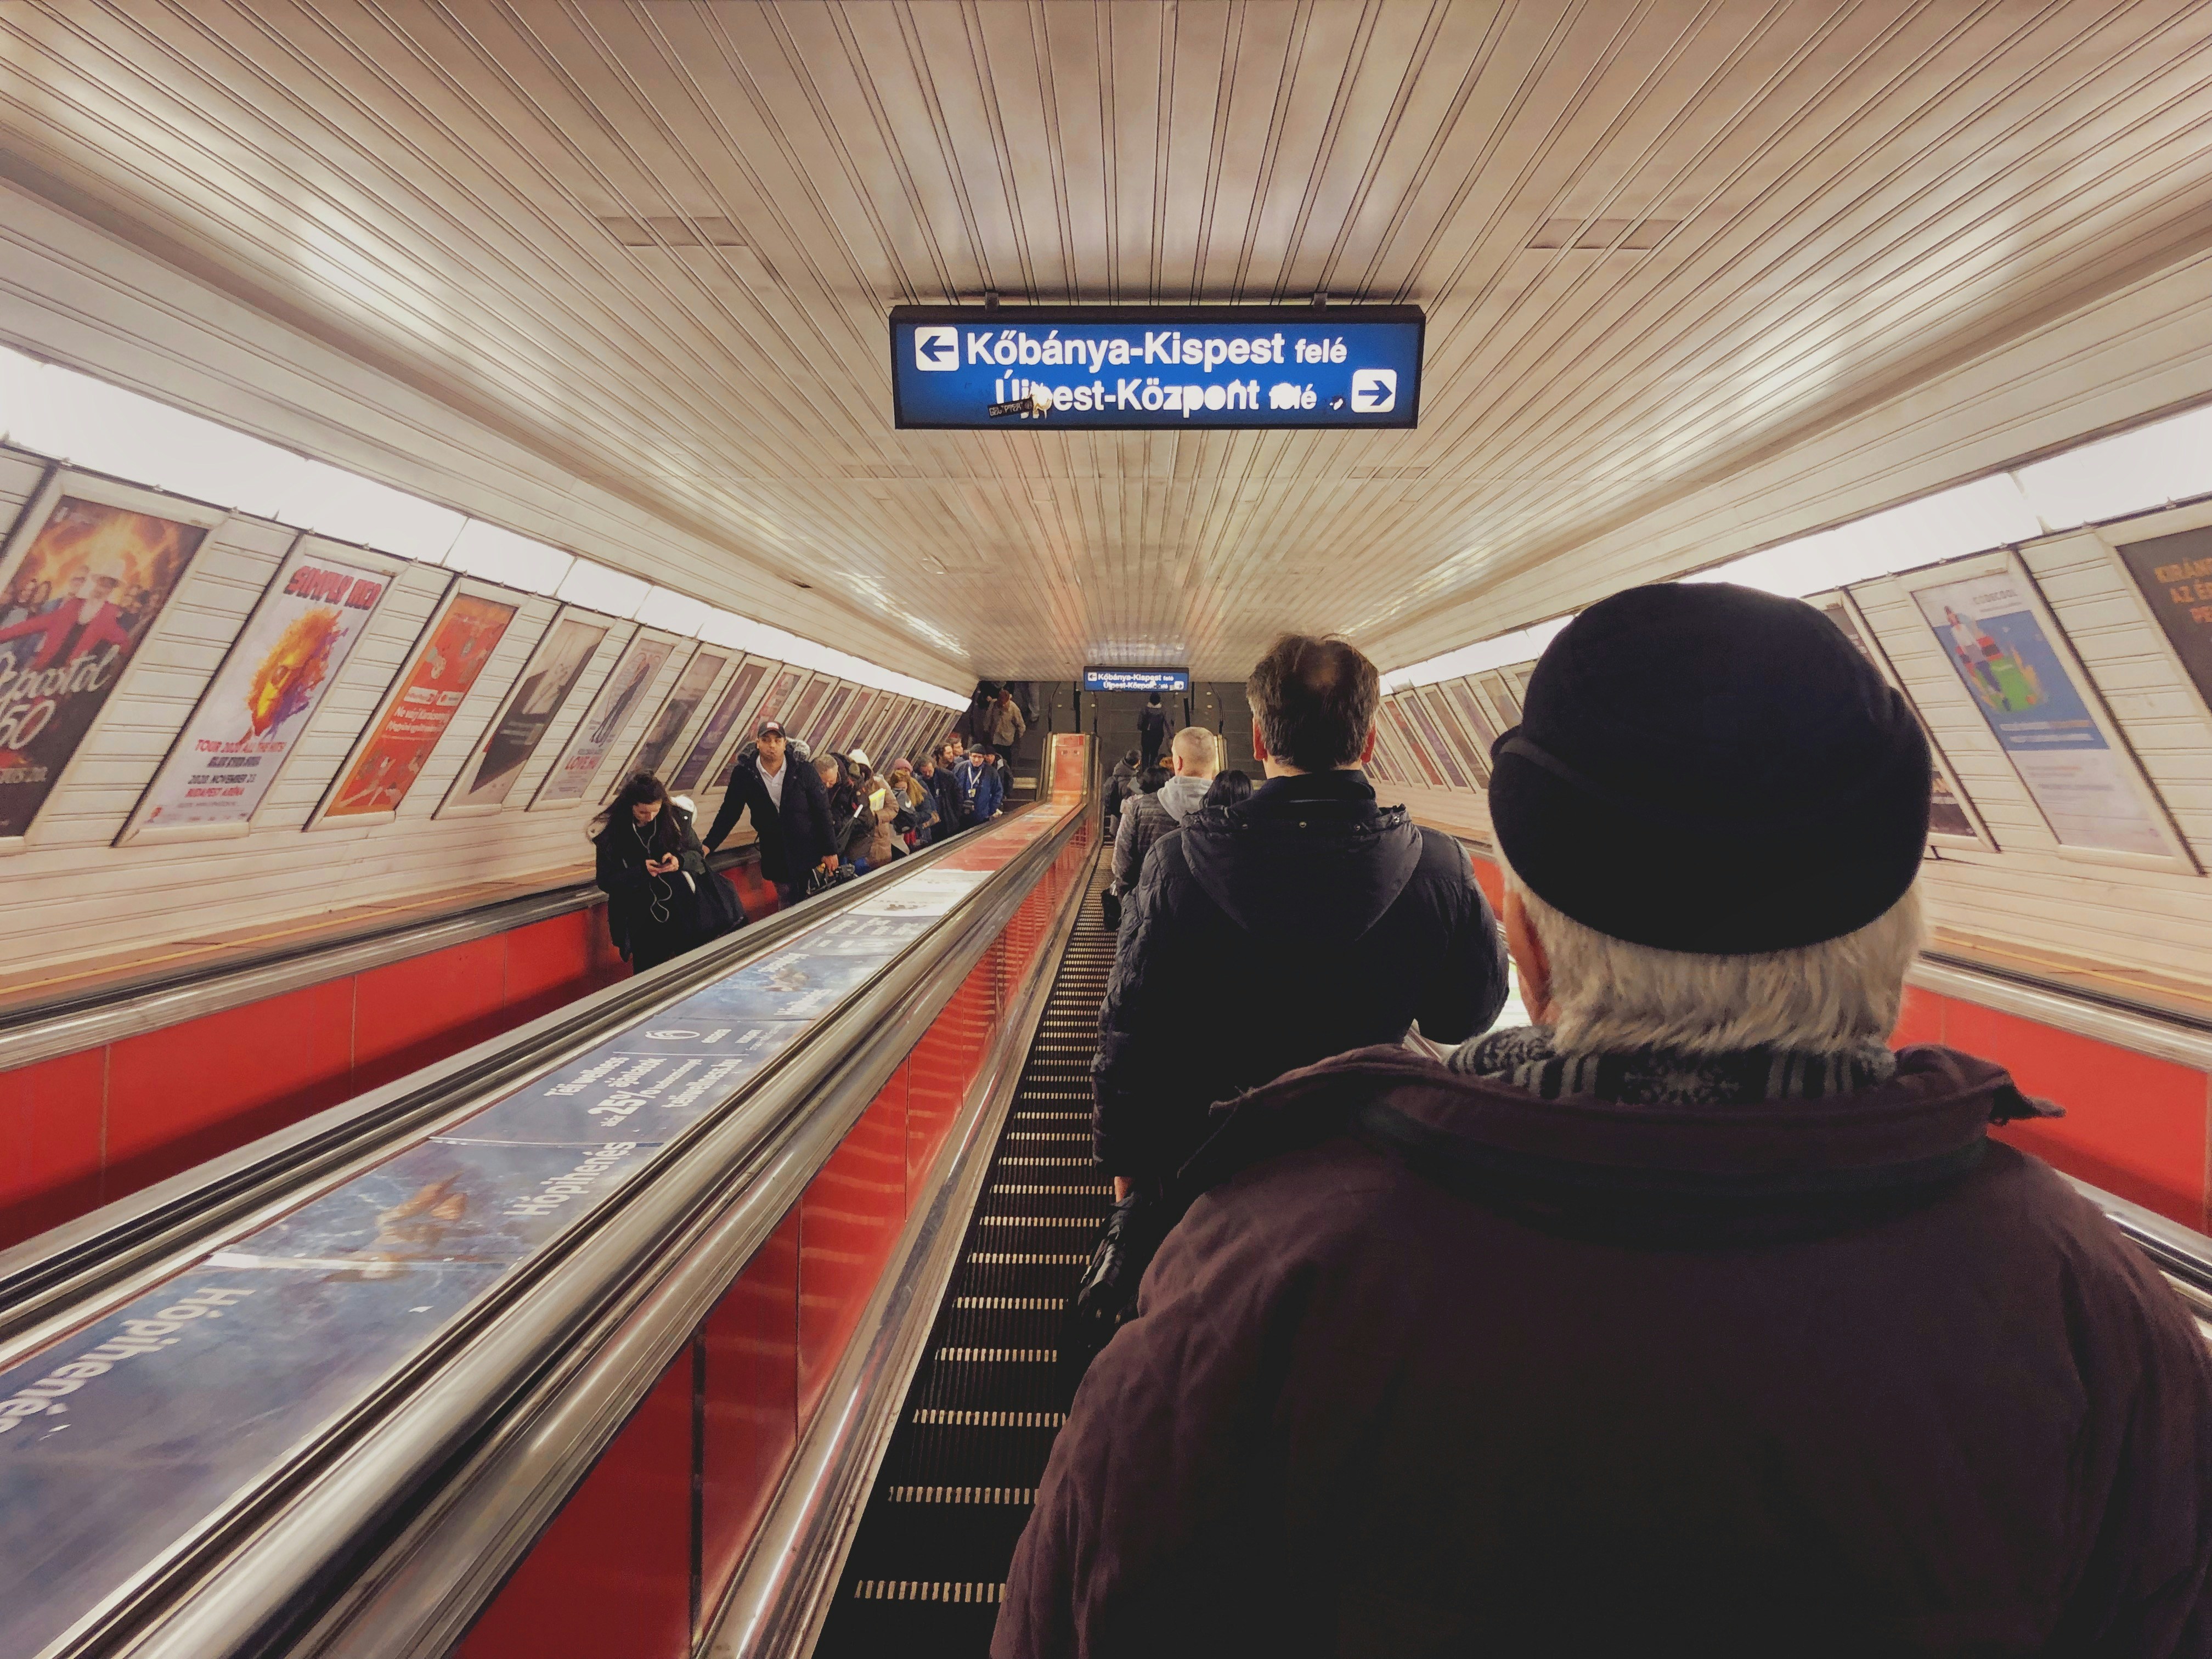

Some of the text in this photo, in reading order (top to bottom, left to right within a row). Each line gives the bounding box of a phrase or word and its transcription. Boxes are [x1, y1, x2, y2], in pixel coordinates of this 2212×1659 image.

[967, 330, 1347, 374] Kőbánya-Kispest felé
[283, 565, 382, 611] SIMPLY RED
[0, 645, 120, 708] postol
[1098, 673, 1161, 682] Kőbánya-Kispest
[571, 1057, 630, 1083] wellness
[588, 1089, 662, 1115] 25%
[503, 1142, 637, 1216] Hópihenés
